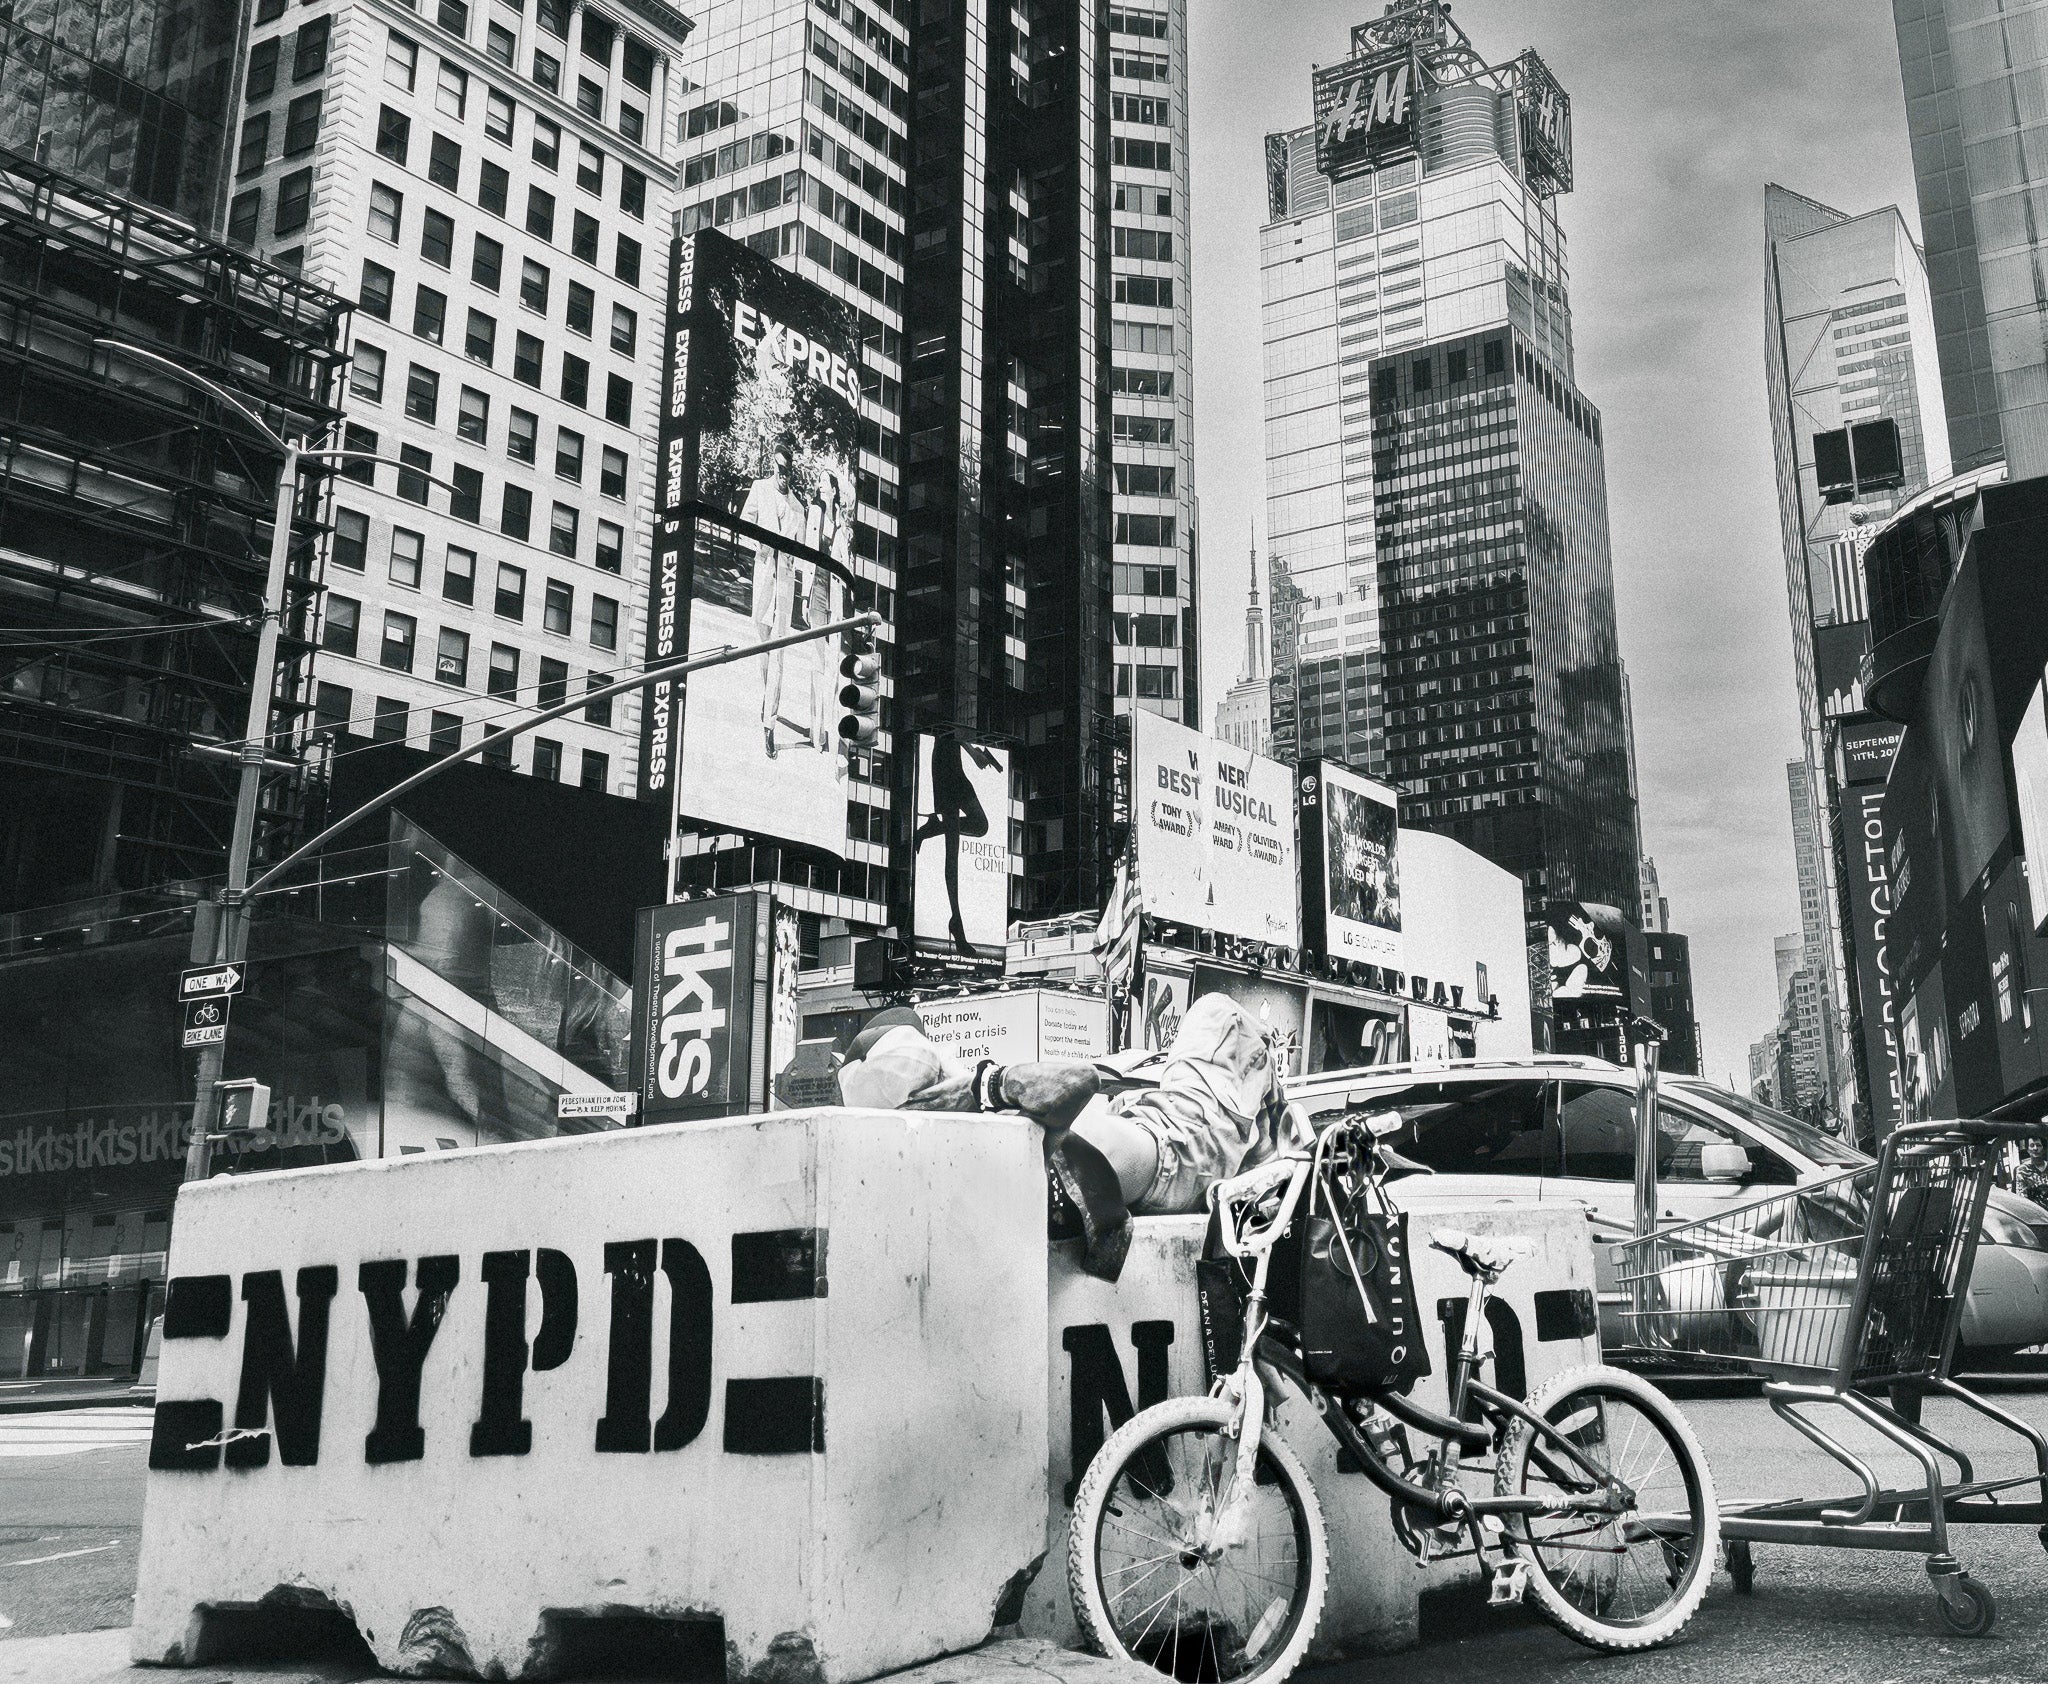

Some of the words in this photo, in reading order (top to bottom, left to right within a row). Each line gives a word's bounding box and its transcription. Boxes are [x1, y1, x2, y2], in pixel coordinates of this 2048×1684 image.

[1321, 65, 1409, 149] H&M
[671, 329, 690, 418] EXPRESS
[664, 437, 684, 534] EXPRES
[657, 550, 678, 656] EXPRESS
[649, 680, 671, 790] EXPRESS
[1157, 764, 1201, 801] BEST
[1303, 794, 1317, 807] LG
[1158, 818, 1187, 837] AWARD
[1212, 835, 1234, 851] WARD
[1252, 849, 1278, 865] AWARD
[1161, 802, 1183, 820] TONY
[1252, 832, 1279, 850] OLIVIER
[962, 840, 1006, 859] PERFECT
[1343, 930, 1354, 946] LG
[189, 976, 208, 991] ONE
[215, 973, 235, 987] WAY
[658, 916, 735, 1099] tkts
[922, 1012, 952, 1028] Right
[955, 1011, 982, 1023] now,
[186, 1030, 202, 1043] BIKE
[203, 1027, 223, 1040] LANE
[925, 1029, 961, 1043] here's
[964, 1031, 971, 1040] a
[974, 1023, 1008, 1038] crisis
[1063, 1022, 1077, 1031] today
[1078, 1023, 1088, 1032] and
[1064, 1035, 1073, 1044] the
[561, 1096, 596, 1105] PEDESTRIAN
[1200, 1290, 1212, 1325] DEAN
[224, 1238, 714, 1468] NYPD
